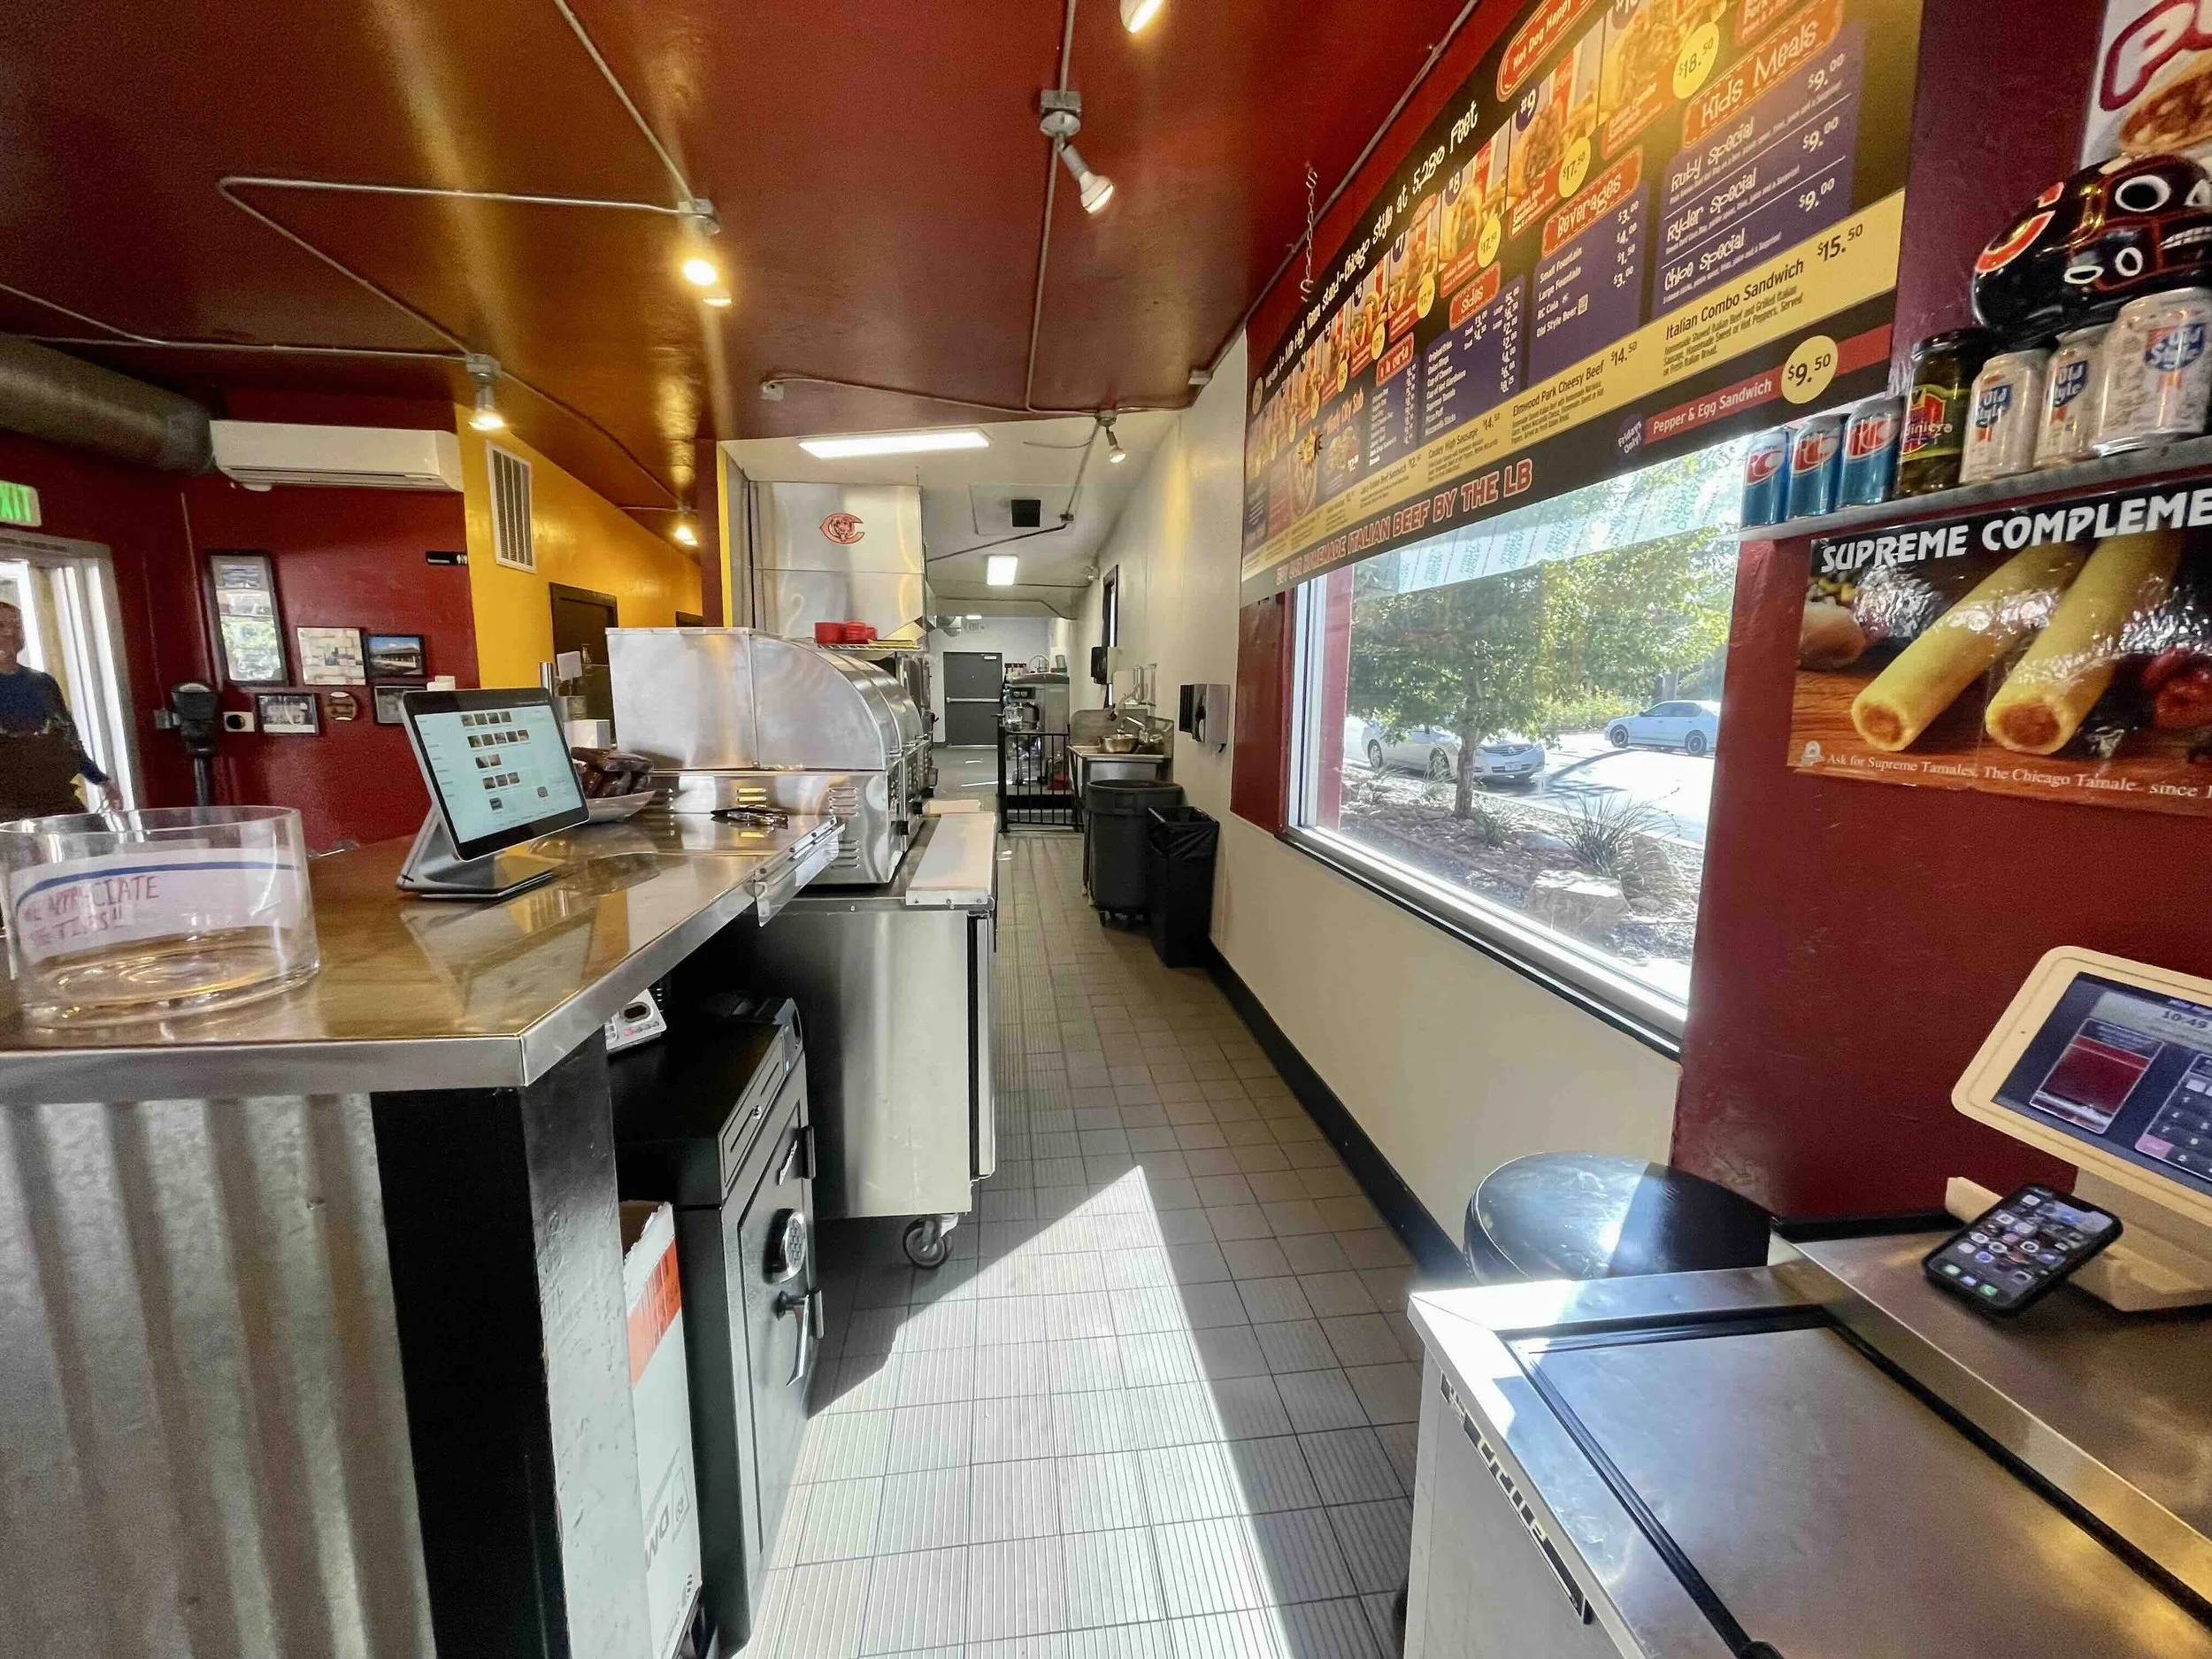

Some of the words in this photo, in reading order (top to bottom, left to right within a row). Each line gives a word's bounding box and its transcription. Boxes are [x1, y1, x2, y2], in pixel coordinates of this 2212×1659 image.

[1701, 77, 1744, 128] Kids
[1754, 20, 1818, 88] Meals
[1449, 100, 1479, 154] Feet
[1671, 155, 1702, 192] Ruby
[1708, 117, 1755, 165] Special
[1557, 173, 1622, 239] Beverages
[1667, 206, 1703, 242] Ryder
[1709, 167, 1757, 213] Special
[1700, 228, 1746, 271] Special
[1665, 316, 1698, 340] Italian
[1701, 293, 1740, 322] Combo
[1743, 258, 1804, 300] Sandwich
[1541, 386, 1556, 403] Park
[1558, 372, 1585, 393] Cheesy
[1586, 359, 1604, 380] Beef
[1653, 413, 1686, 434] Pepper
[1687, 411, 1695, 421] &
[1697, 403, 1717, 419] Egg
[1718, 378, 1772, 411] Sandwich
[1348, 516, 1391, 555] ITALIAN
[1392, 498, 1431, 538] BEEF
[1432, 488, 1458, 523] BY
[1461, 471, 1500, 512] THE
[1503, 457, 1533, 499] LB
[1821, 525, 1969, 573] SUPREME
[1981, 488, 2212, 551] COMPLEME
[1827, 754, 1846, 765] Ask
[1850, 755, 1864, 767] for
[1868, 757, 1917, 772] Supreme
[1983, 765, 2008, 780] The
[2012, 768, 2070, 787] Chicago
[2149, 781, 2199, 797] since
